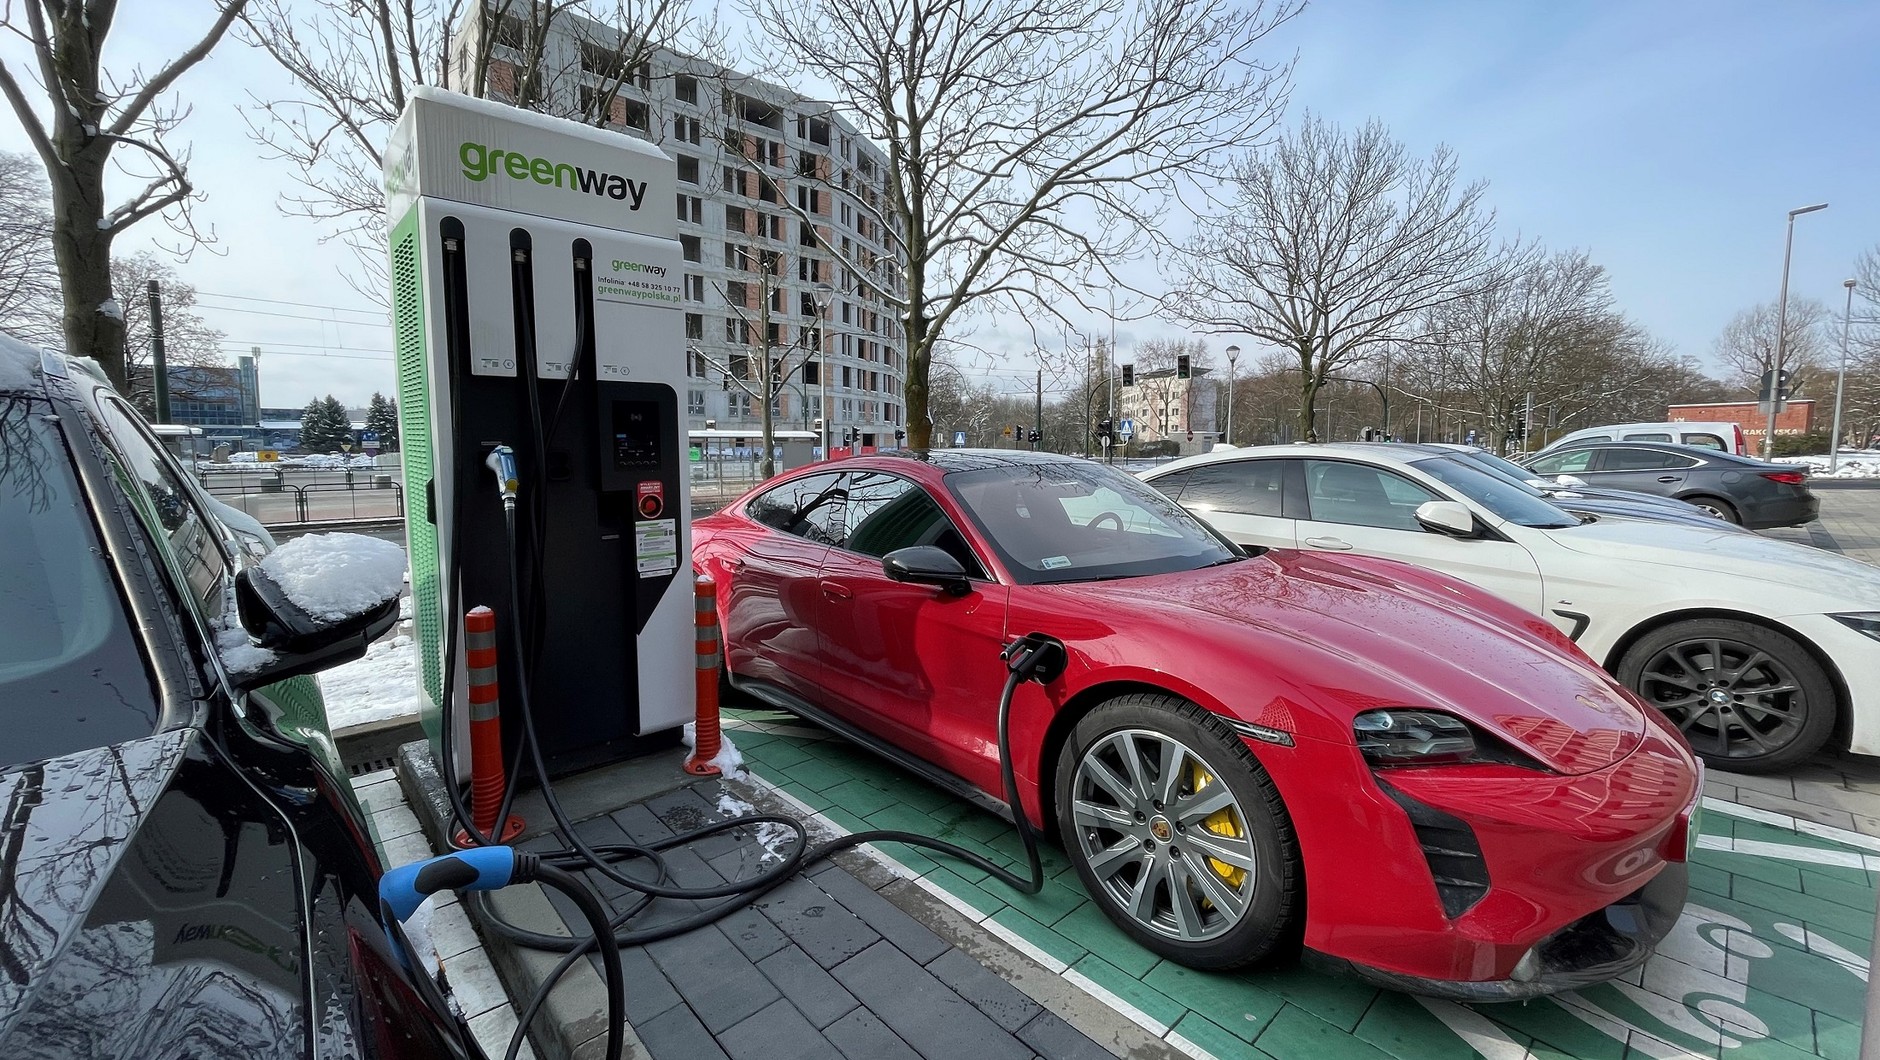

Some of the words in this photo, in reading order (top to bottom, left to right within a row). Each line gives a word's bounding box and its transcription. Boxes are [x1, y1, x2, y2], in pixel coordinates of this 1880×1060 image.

[459, 142, 647, 211] greenway
[611, 259, 666, 278] greenway
[597, 285, 681, 303] greenwaypolska.pl
[650, 283, 663, 291] 325
